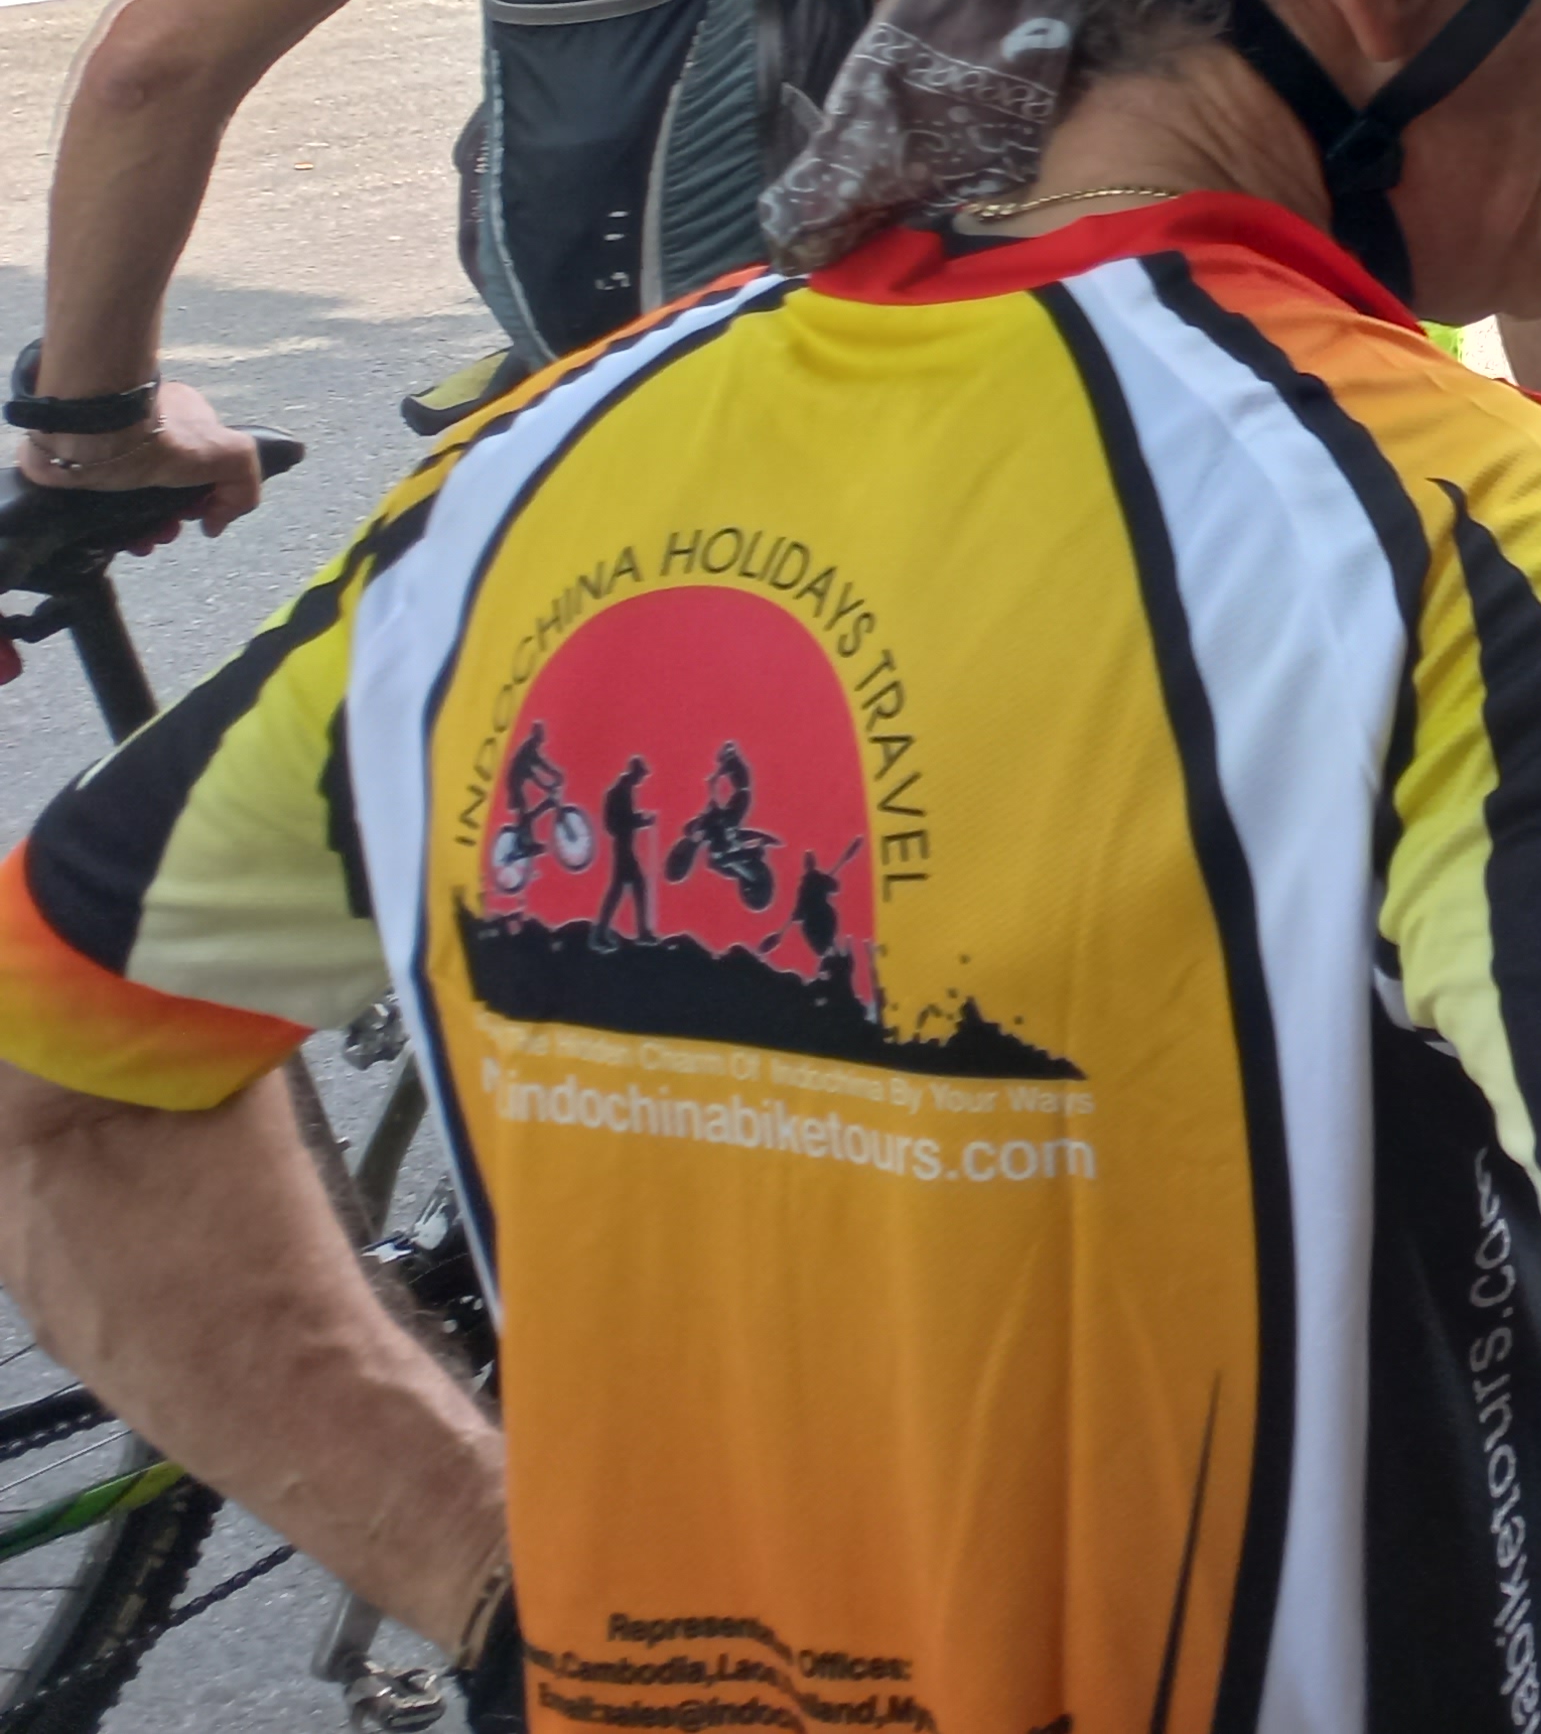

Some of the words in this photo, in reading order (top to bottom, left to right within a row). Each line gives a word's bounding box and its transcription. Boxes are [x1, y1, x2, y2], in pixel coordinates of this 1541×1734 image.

[456, 546, 643, 848] INDOCHINA
[662, 526, 877, 659] HOLIDAYS
[853, 648, 933, 903] TRAVEL
